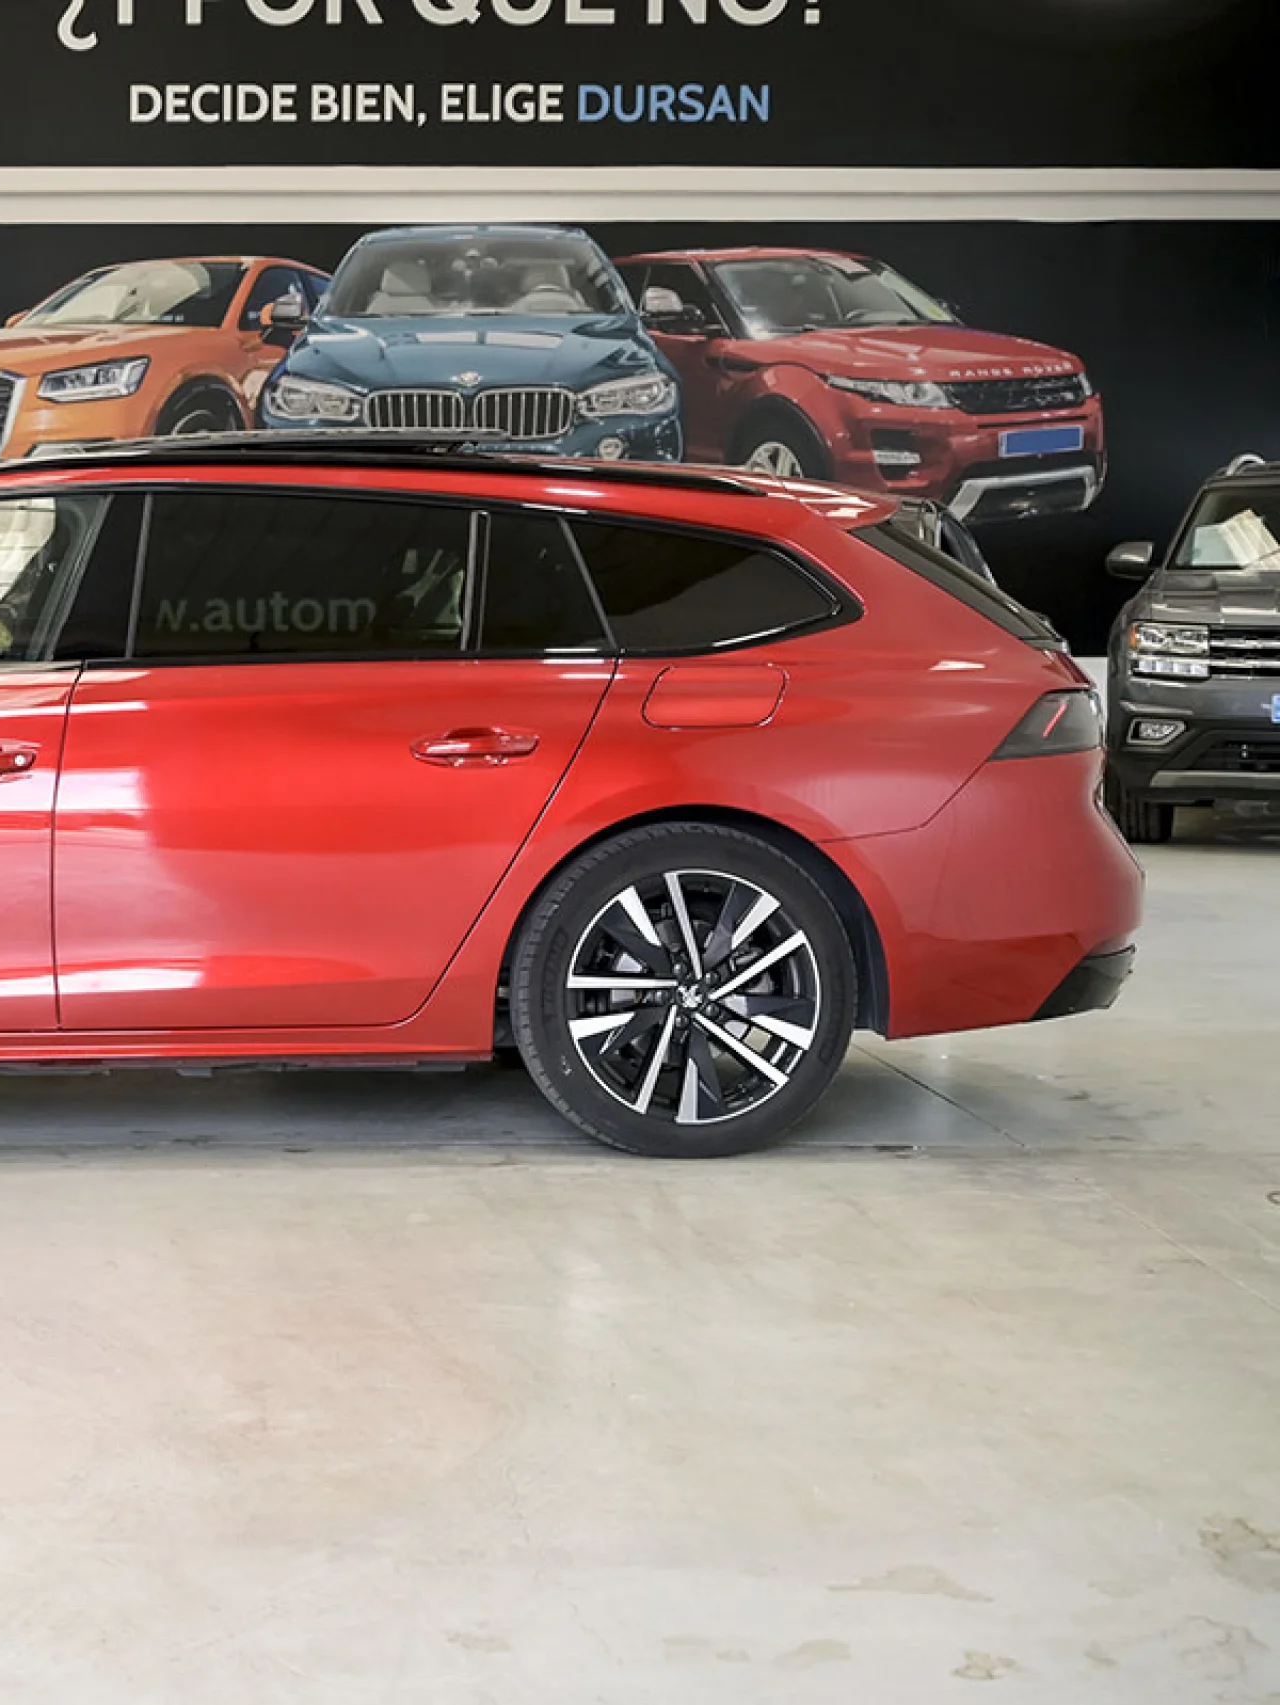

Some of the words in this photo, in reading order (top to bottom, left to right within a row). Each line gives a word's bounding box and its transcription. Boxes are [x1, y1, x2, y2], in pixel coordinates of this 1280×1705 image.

[129, 84, 297, 123] DECIDE
[311, 84, 427, 127] BIEN,
[441, 84, 564, 123] ELIGE
[577, 84, 769, 123] DURSAN
